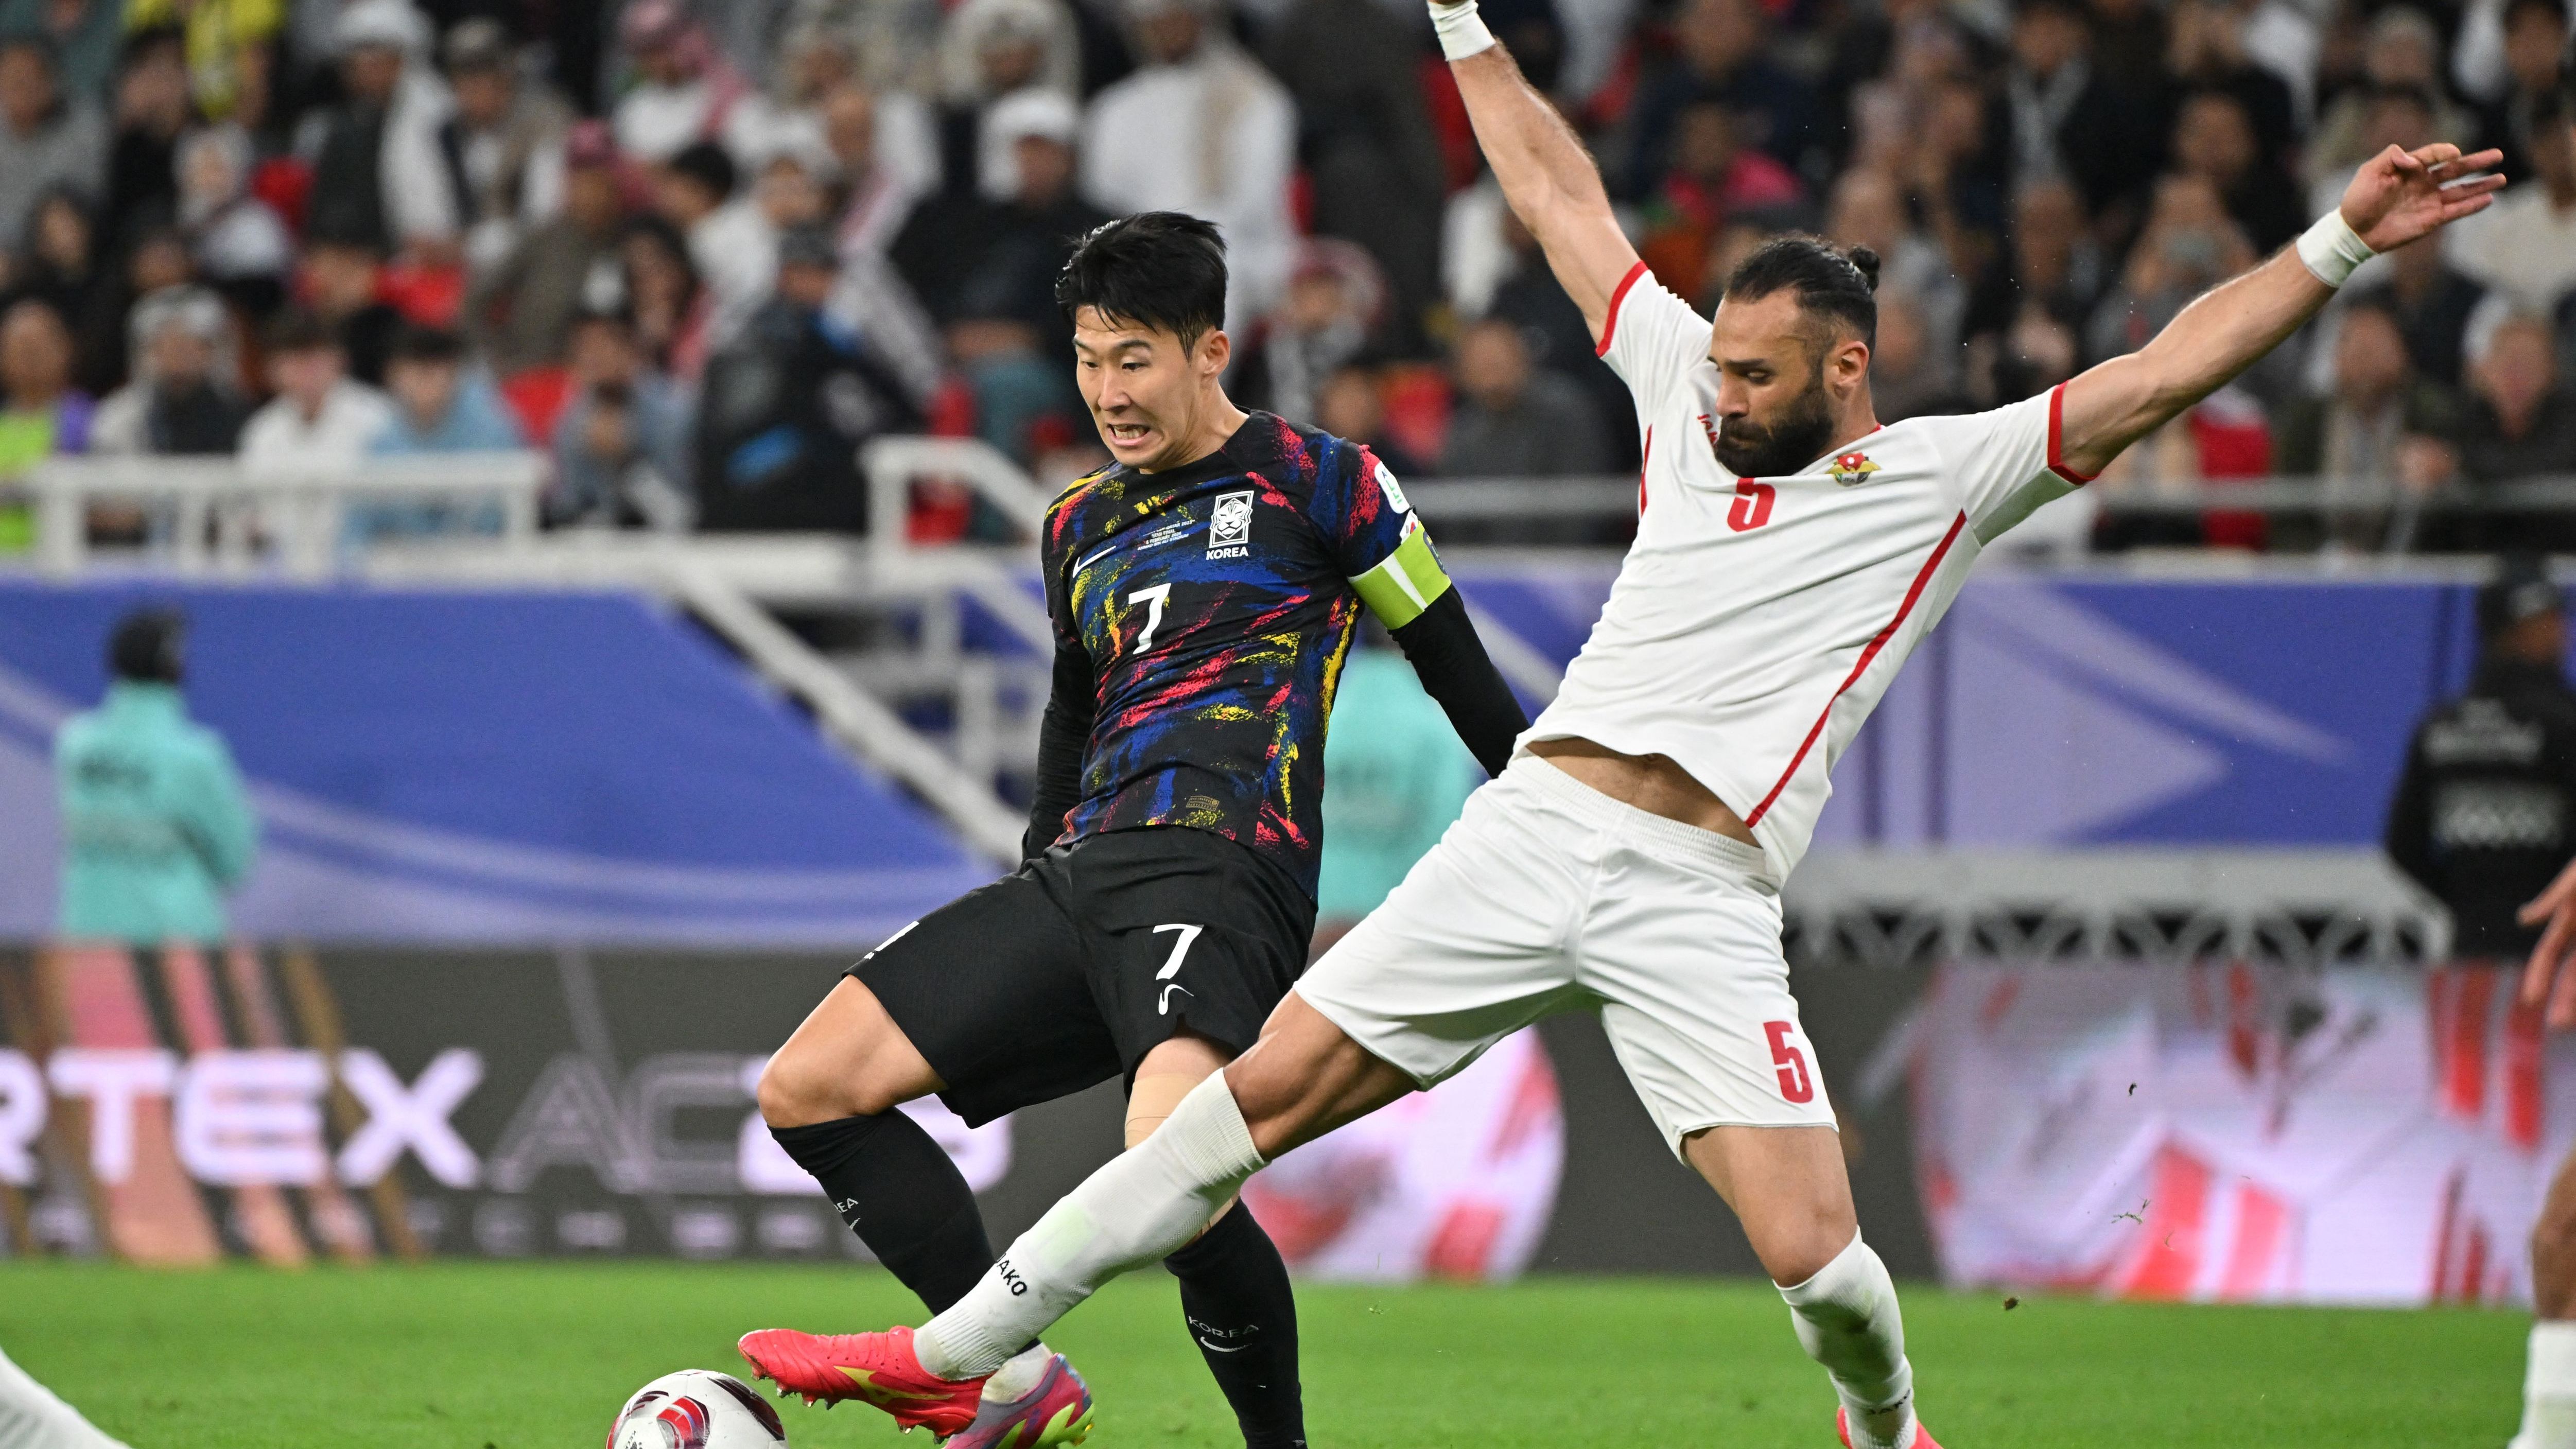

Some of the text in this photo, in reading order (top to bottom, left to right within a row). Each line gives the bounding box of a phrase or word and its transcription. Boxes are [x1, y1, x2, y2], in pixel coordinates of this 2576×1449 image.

[1727, 478, 1776, 532] 5
[1206, 546, 1249, 561] KOREA
[1128, 582, 1172, 655] 7
[1153, 923, 1204, 980] 7
[1763, 1020, 1814, 1104] 5
[834, 1198, 859, 1213] EA
[997, 1252, 1028, 1297] AKO
[1188, 1315, 1259, 1338] KOREA
